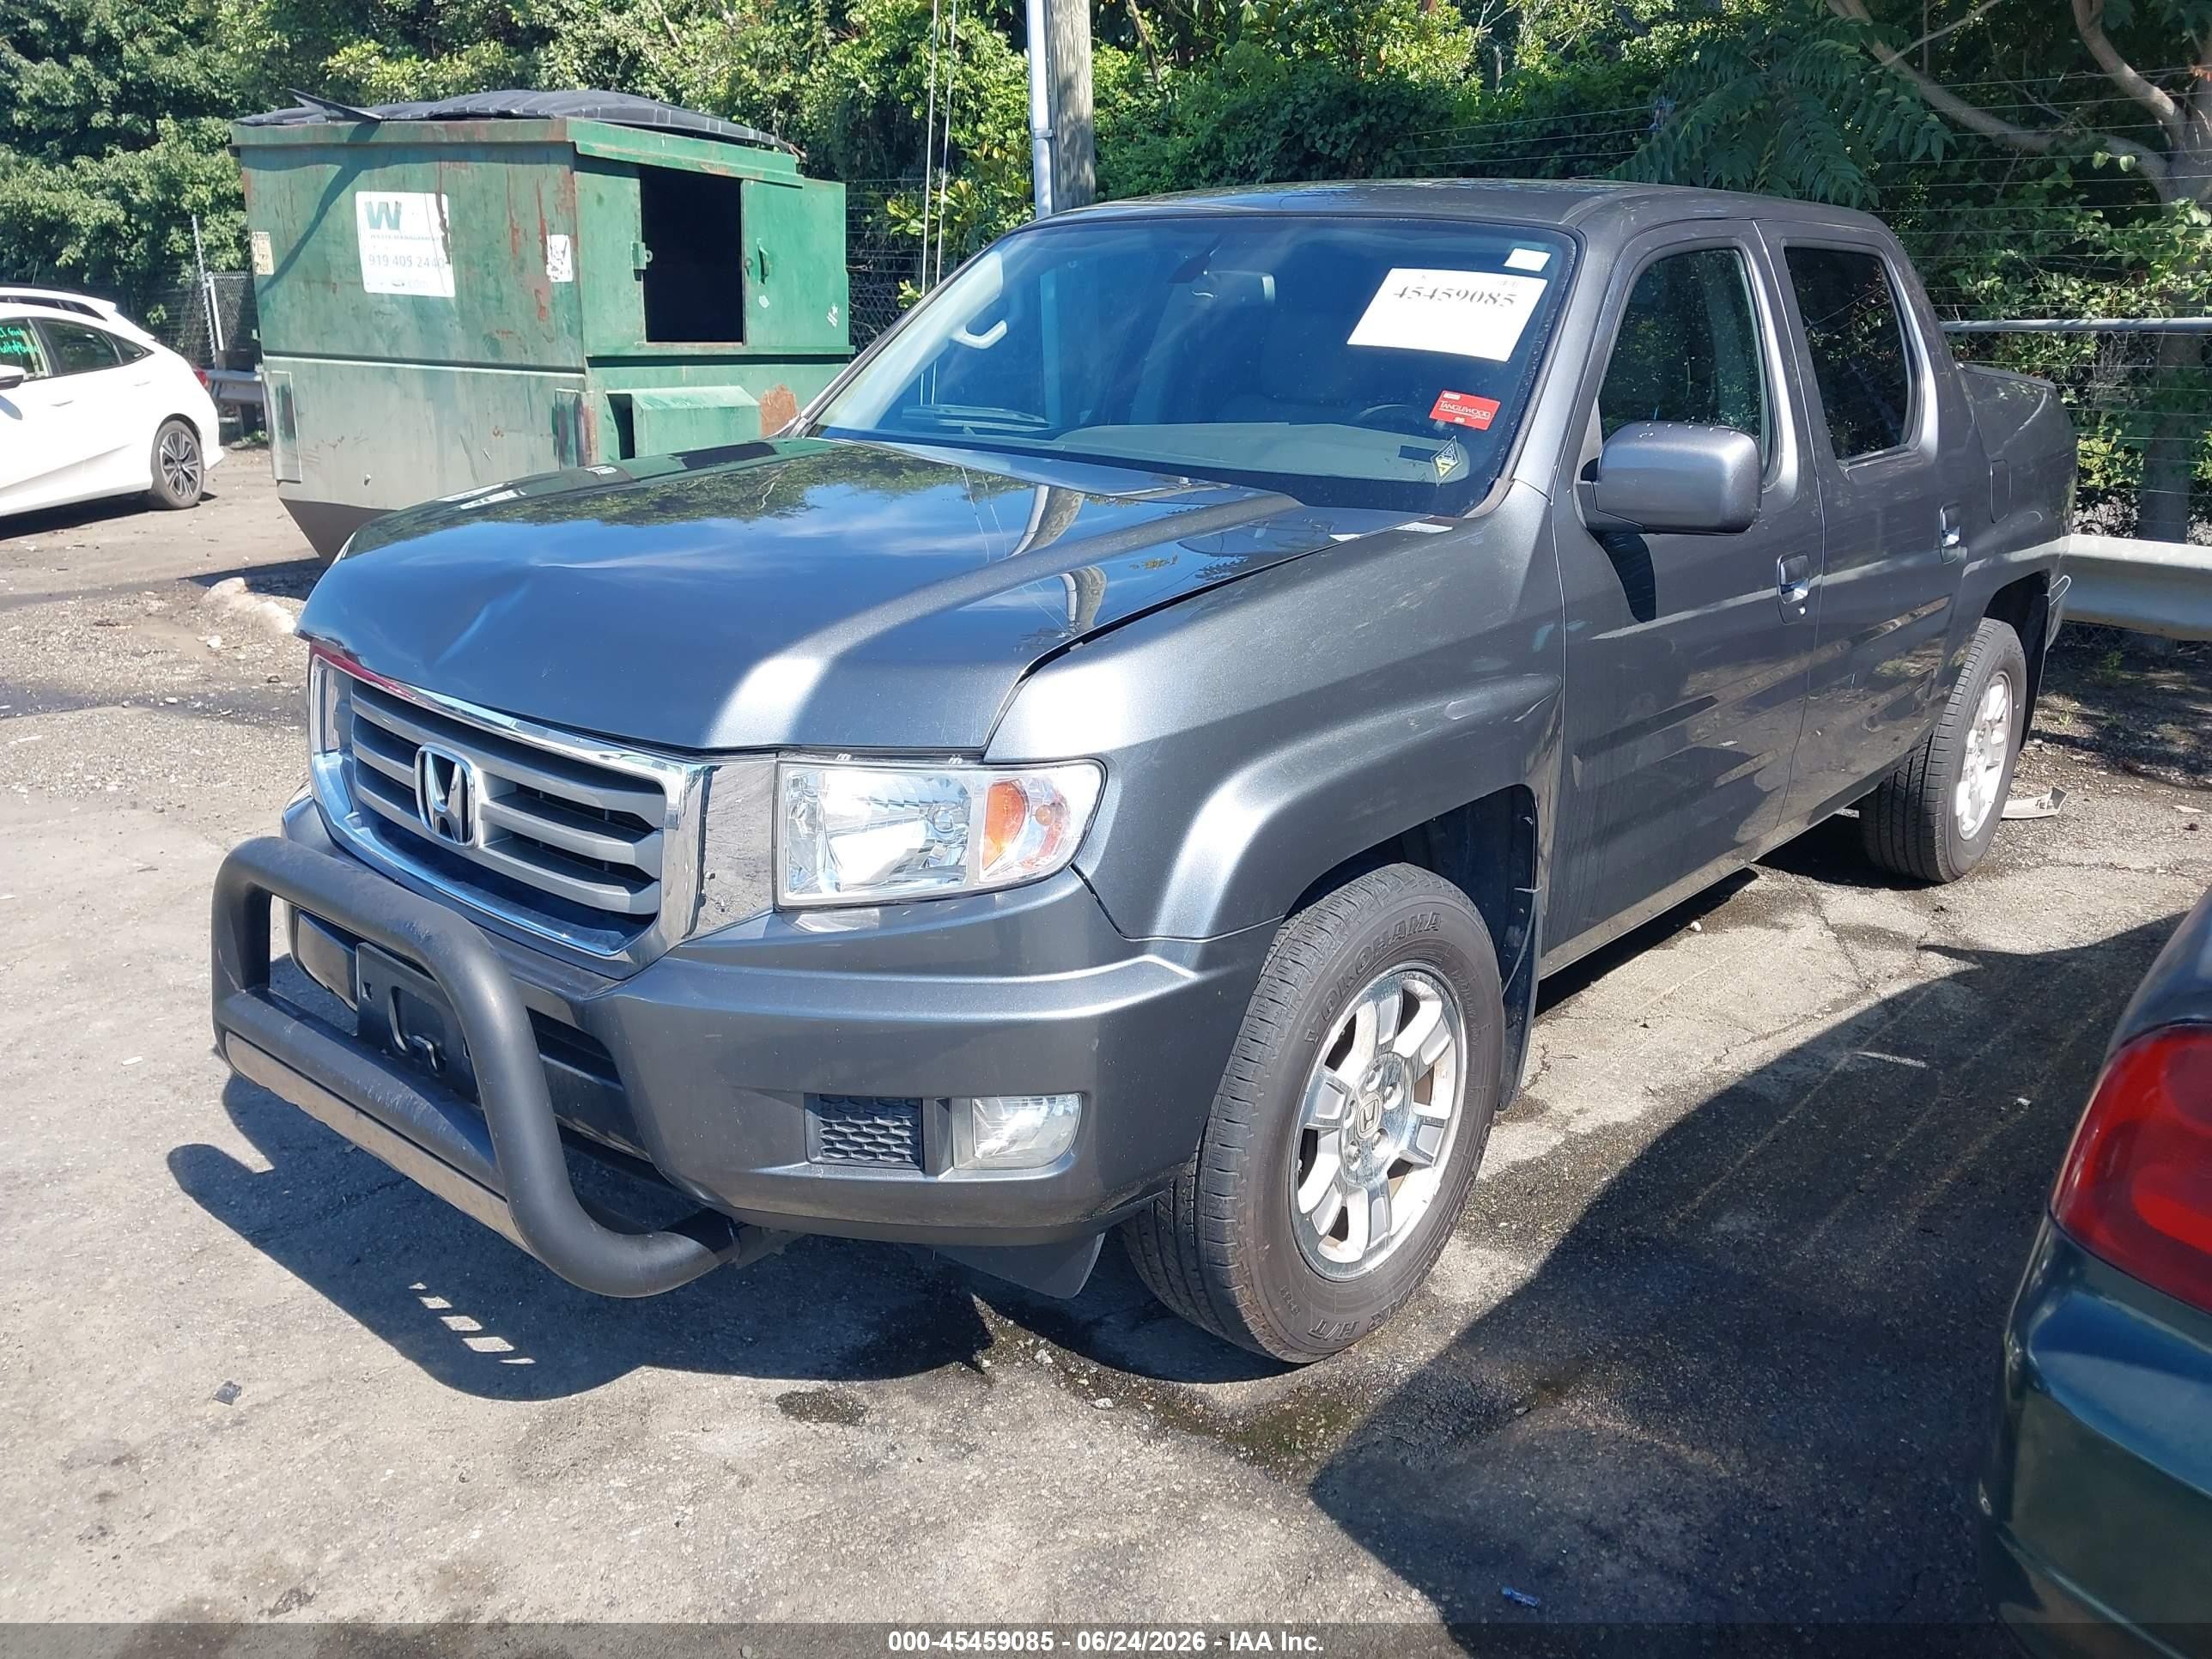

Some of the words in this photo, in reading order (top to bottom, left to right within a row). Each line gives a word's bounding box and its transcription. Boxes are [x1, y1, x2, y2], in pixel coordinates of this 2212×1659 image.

[368, 253, 389, 267] 919
[1395, 285, 1517, 307] 45459085
[1439, 400, 1492, 418] TANGLEWOOD
